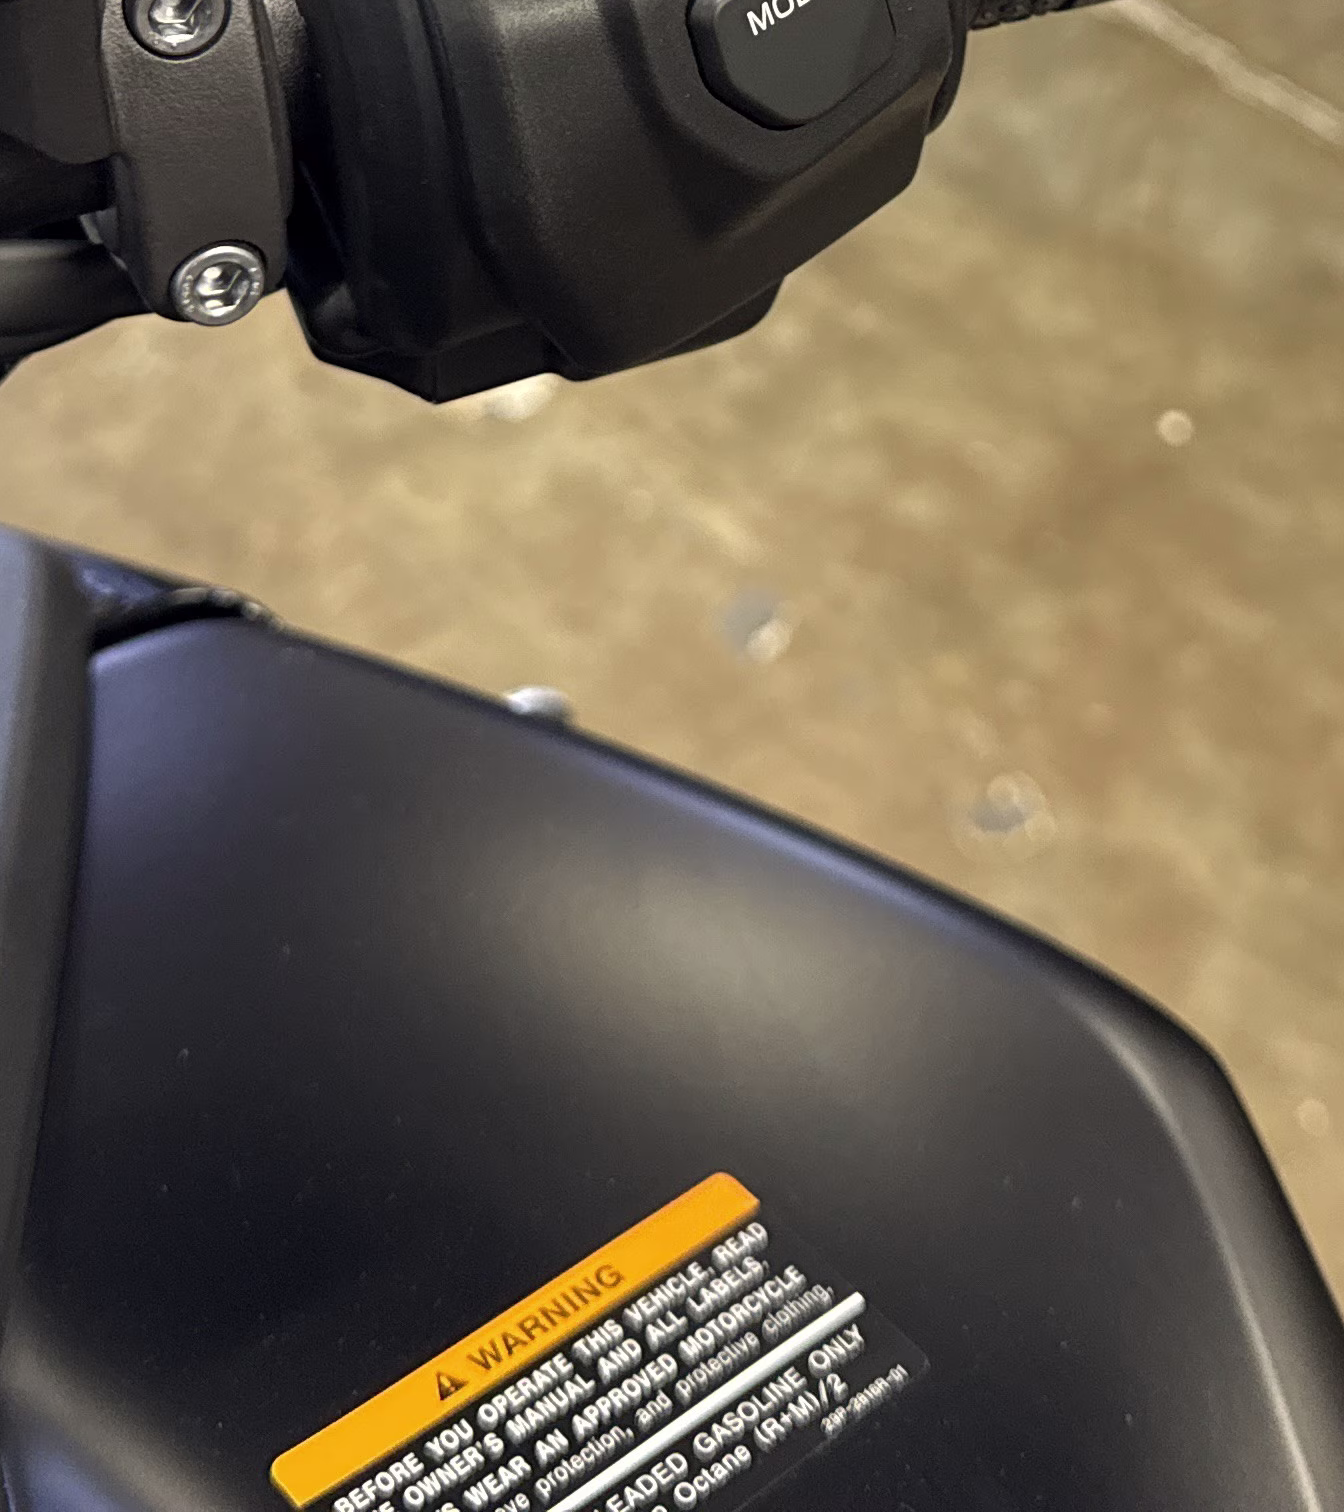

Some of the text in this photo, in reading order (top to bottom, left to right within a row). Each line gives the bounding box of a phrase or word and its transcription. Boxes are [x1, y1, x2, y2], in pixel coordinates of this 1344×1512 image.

[332, 1452, 424, 1512] BEFORE
[424, 1418, 474, 1461] YOU
[476, 1352, 574, 1430] OPERATE
[571, 1319, 624, 1366] THIS
[711, 1222, 768, 1271] READ
[403, 1256, 770, 1509] OWNER'S MANUAL AND ALL LABELS,
[463, 1264, 806, 1509] WEAR AN APPROVED MOTORCYCLE
[466, 1263, 625, 1372] WARNING
[534, 1425, 634, 1499] protection,
[634, 1389, 673, 1431] and
[674, 1331, 761, 1404] protective
[761, 1284, 835, 1341] clothing,
[693, 1366, 807, 1456] GASOLINE
[808, 1322, 865, 1378] ONLY
[673, 1373, 849, 1508] Octane (R+M)/2
